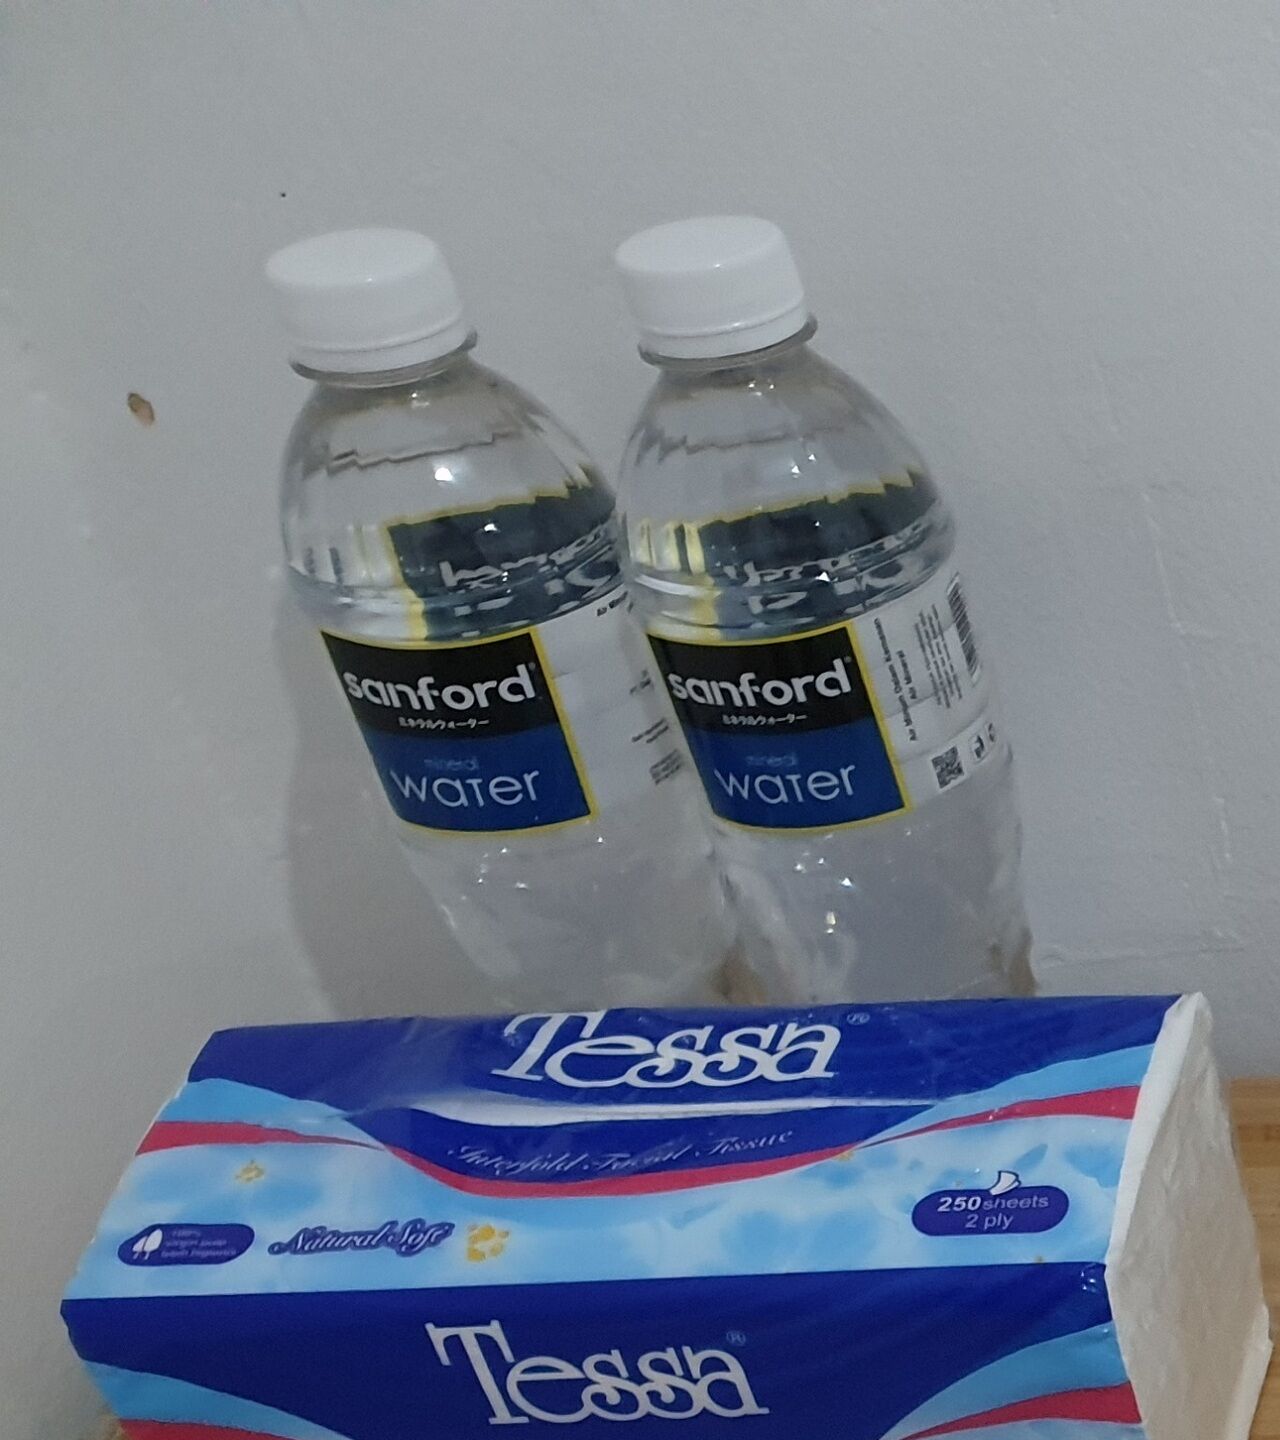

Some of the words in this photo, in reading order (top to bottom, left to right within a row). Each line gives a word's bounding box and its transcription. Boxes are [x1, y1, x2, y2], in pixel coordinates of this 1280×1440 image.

[343, 663, 536, 711] sanford
[667, 658, 853, 707] sanford
[390, 767, 540, 808] water
[714, 763, 855, 804] water
[490, 1009, 842, 1088] Tessa
[937, 1196, 981, 1212] 250
[982, 1194, 1049, 1211] sheets
[965, 1214, 979, 1228] 2
[983, 1213, 1014, 1231] ply
[270, 1221, 393, 1253] Natural
[394, 1219, 454, 1255] Soft
[425, 1319, 770, 1424] Tessa
